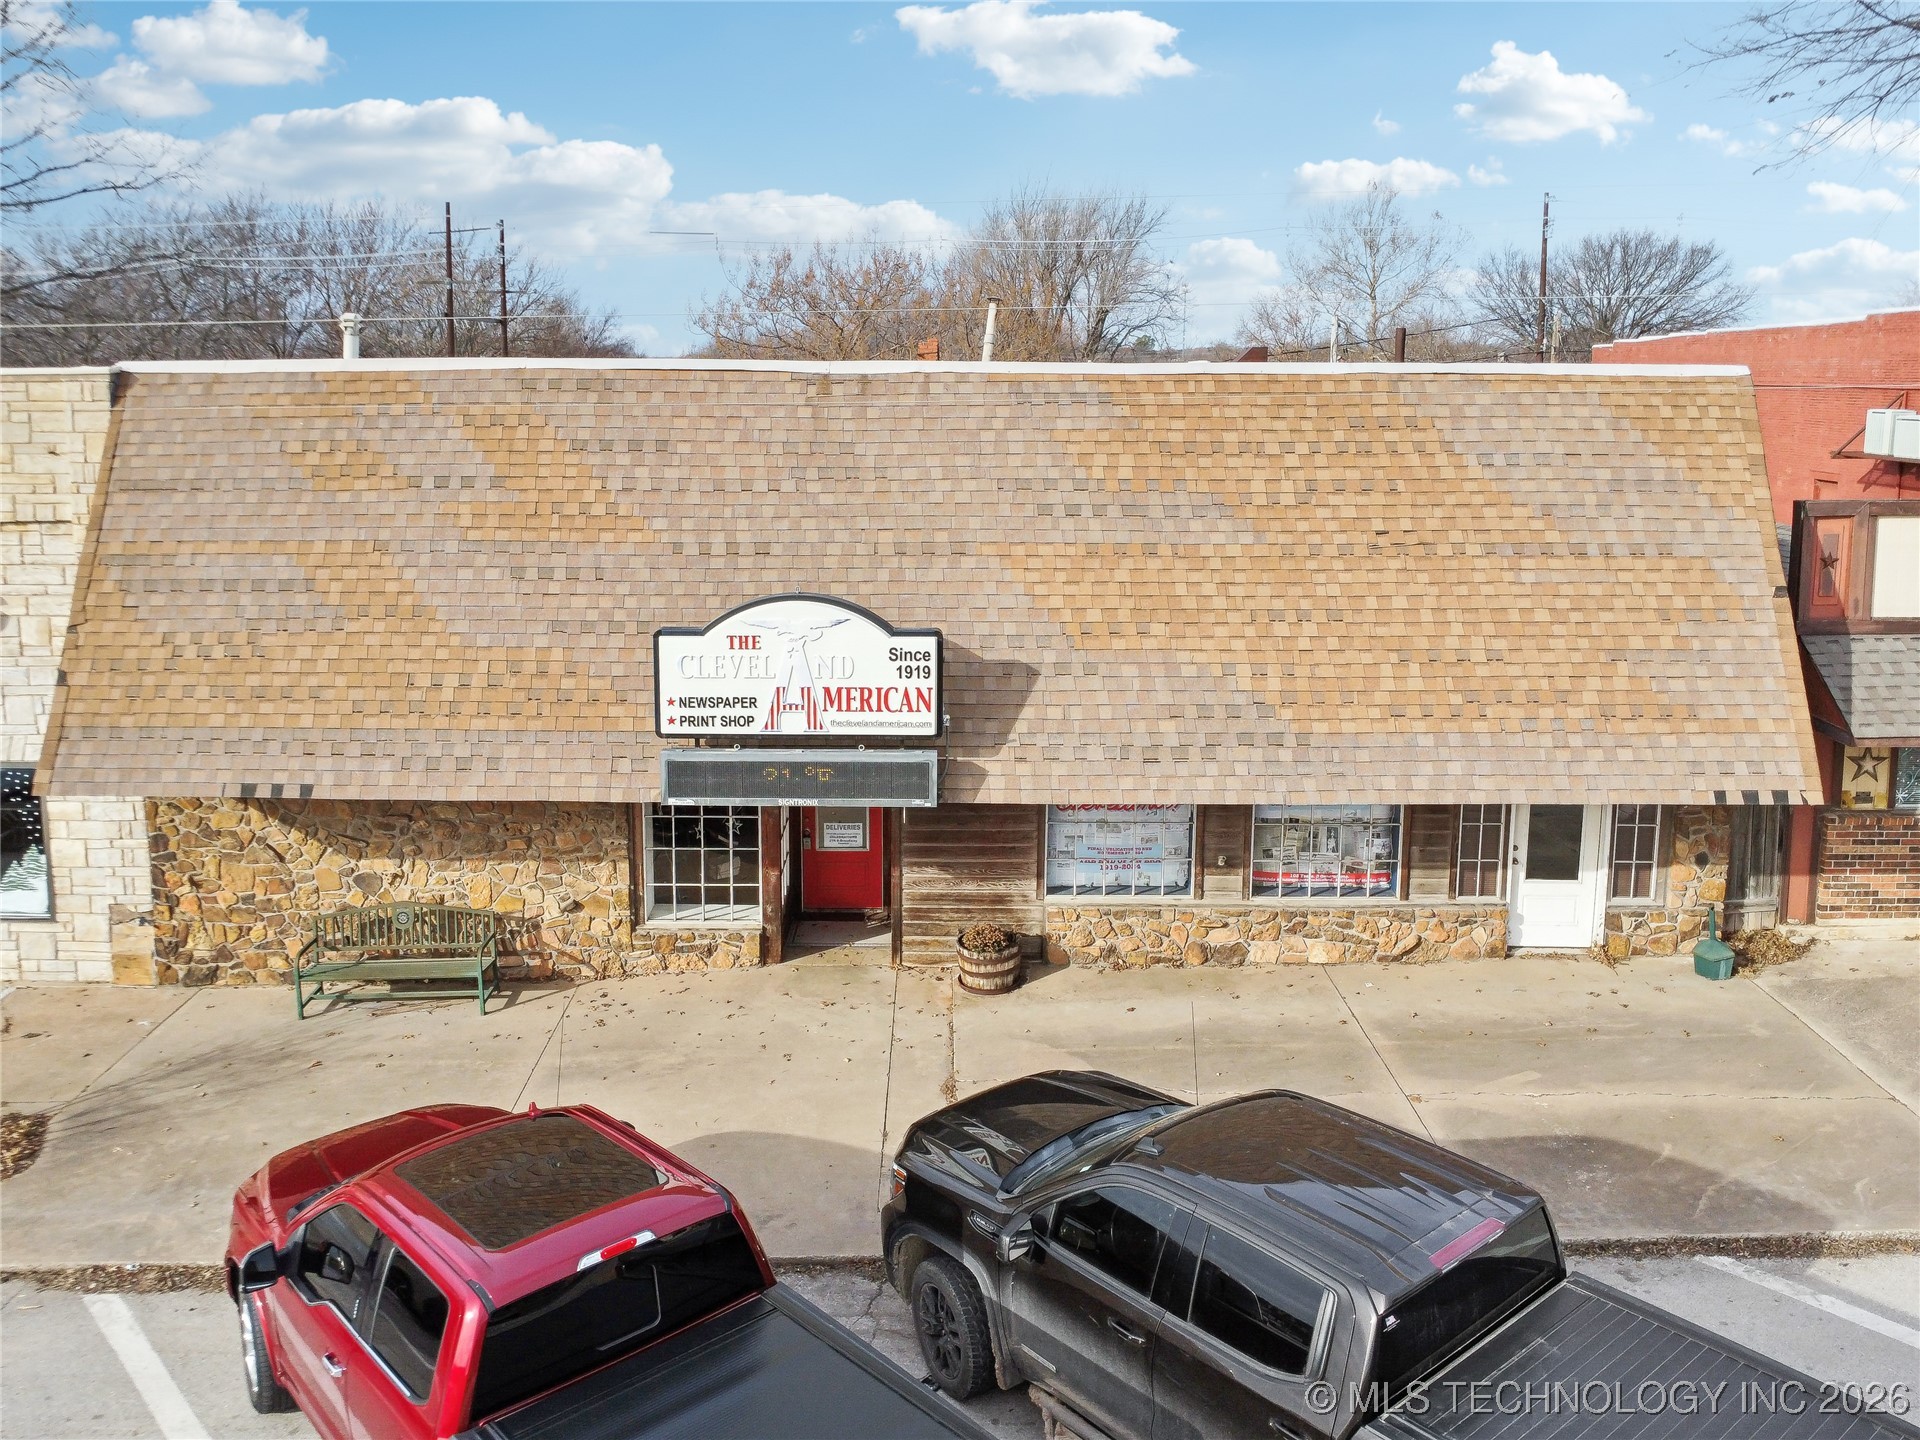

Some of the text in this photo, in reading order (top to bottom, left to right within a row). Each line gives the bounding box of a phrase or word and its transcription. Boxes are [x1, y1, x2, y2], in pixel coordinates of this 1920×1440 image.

[726, 635, 762, 650] THE
[888, 647, 931, 662] Since
[896, 665, 931, 680] 1919
[678, 696, 758, 709] NEWSPAPER
[679, 715, 755, 727] PRINT SHOP
[830, 719, 932, 729] theclevelandamerican.com
